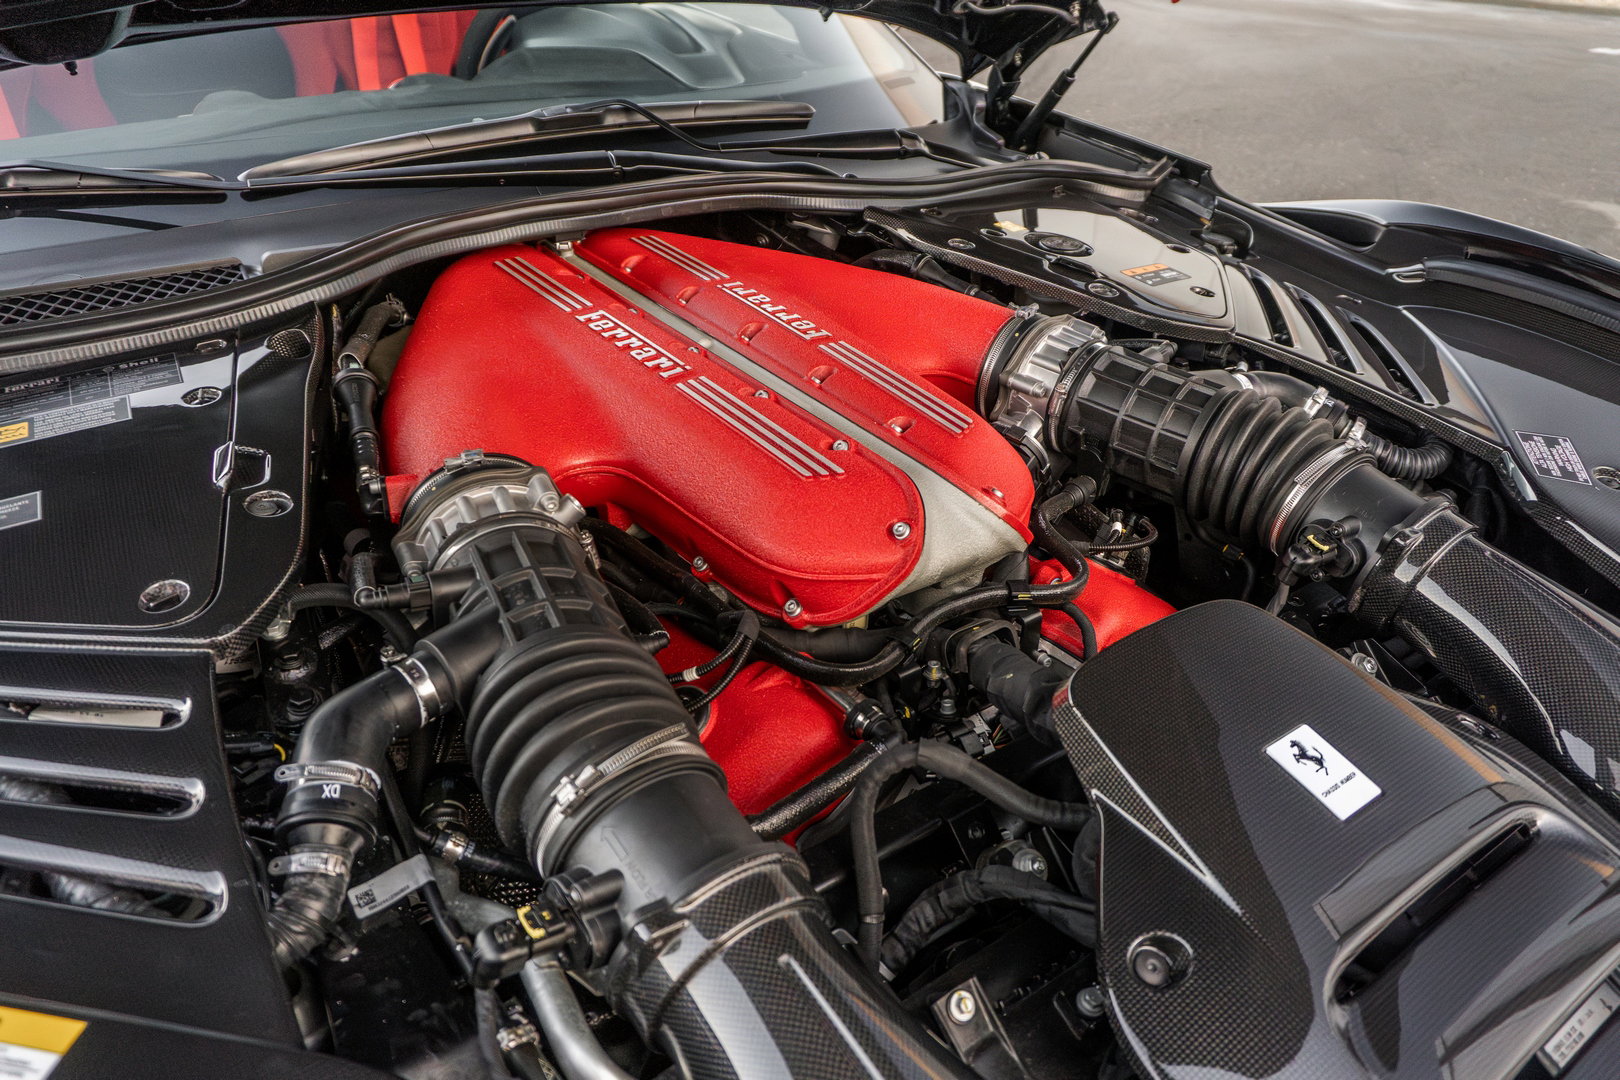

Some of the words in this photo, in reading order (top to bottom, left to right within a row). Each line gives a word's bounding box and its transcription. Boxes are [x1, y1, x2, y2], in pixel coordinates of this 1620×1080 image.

[716, 281, 833, 341] Ferrari
[574, 309, 692, 379] Ferrari
[119, 357, 158, 369] Shell
[5, 376, 60, 393] Ferrari
[321, 783, 341, 799] DX
